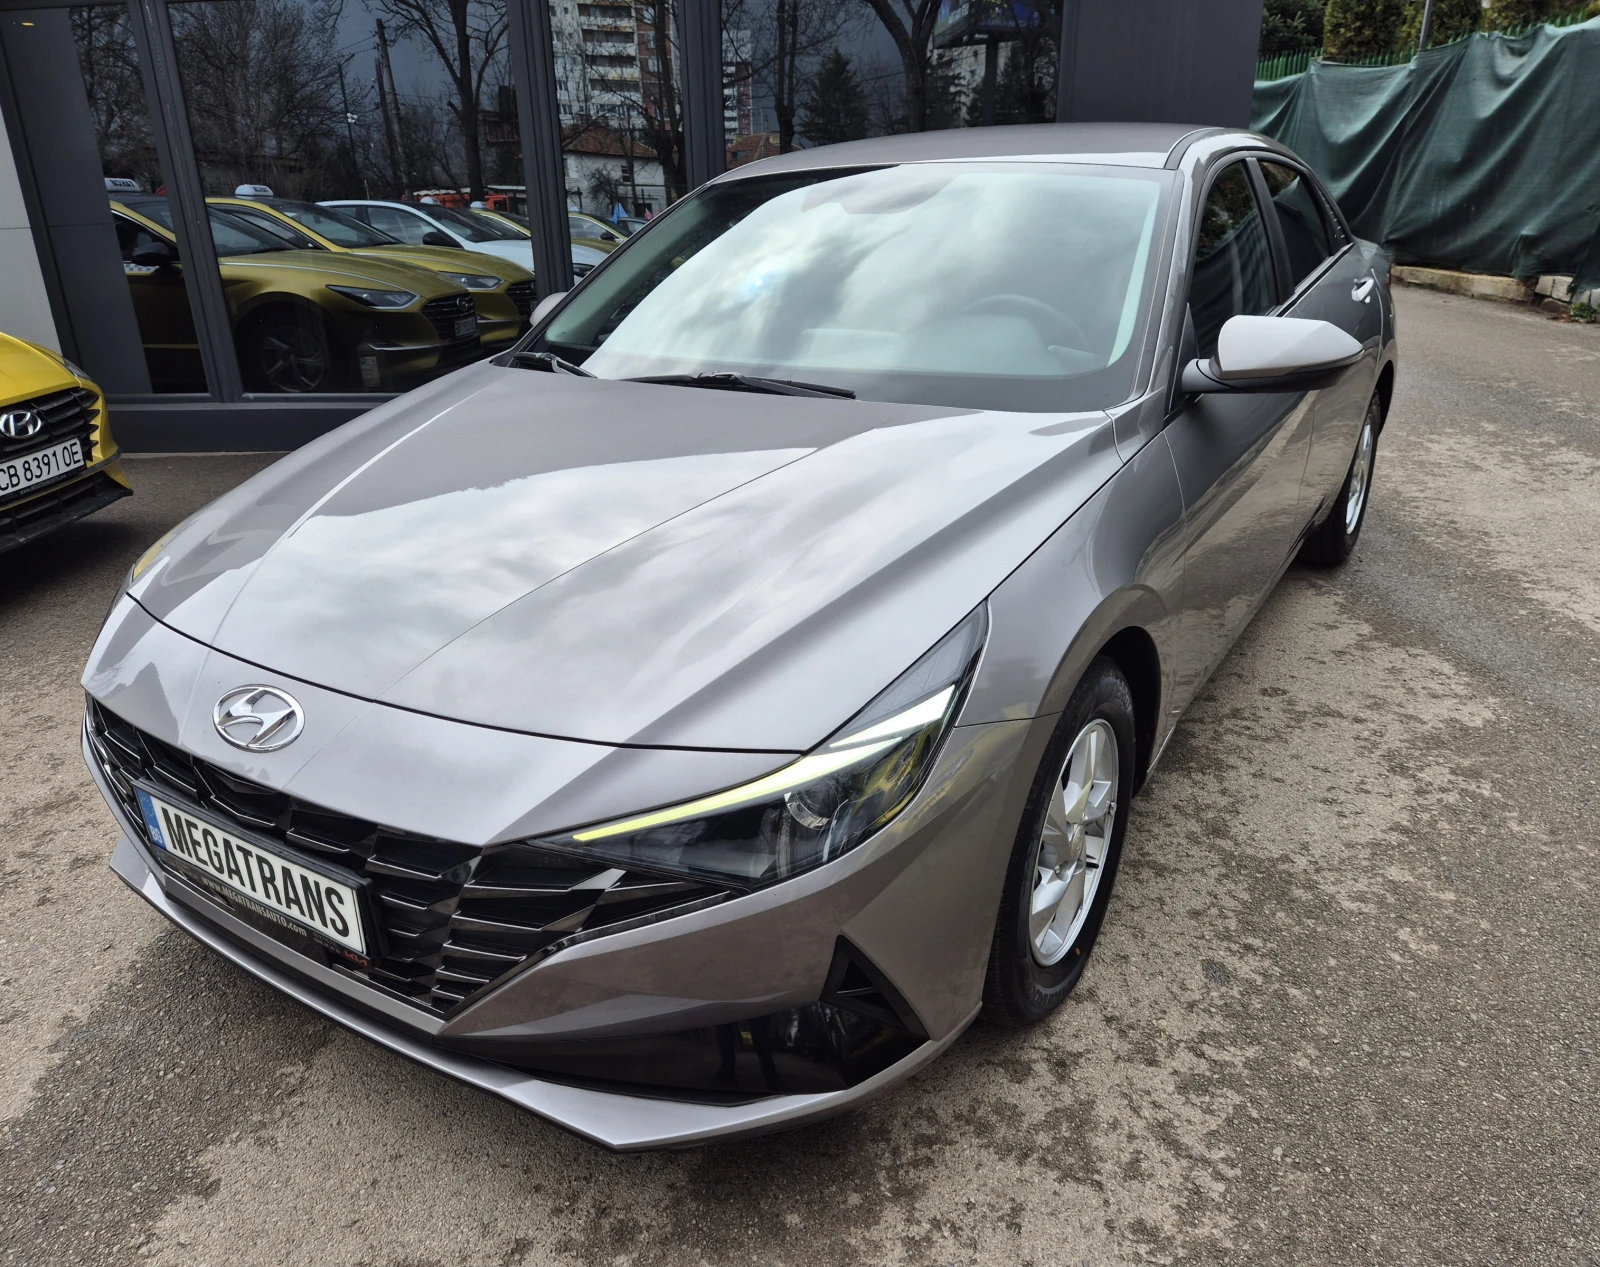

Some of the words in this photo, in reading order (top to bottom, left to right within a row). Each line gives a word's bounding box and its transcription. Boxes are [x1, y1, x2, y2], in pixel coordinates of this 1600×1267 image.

[23, 450, 60, 482] 8391
[149, 824, 163, 844] BG
[162, 807, 350, 938] MEGATRANS
[202, 875, 308, 938] www.MEGATRANSAUTO.com
